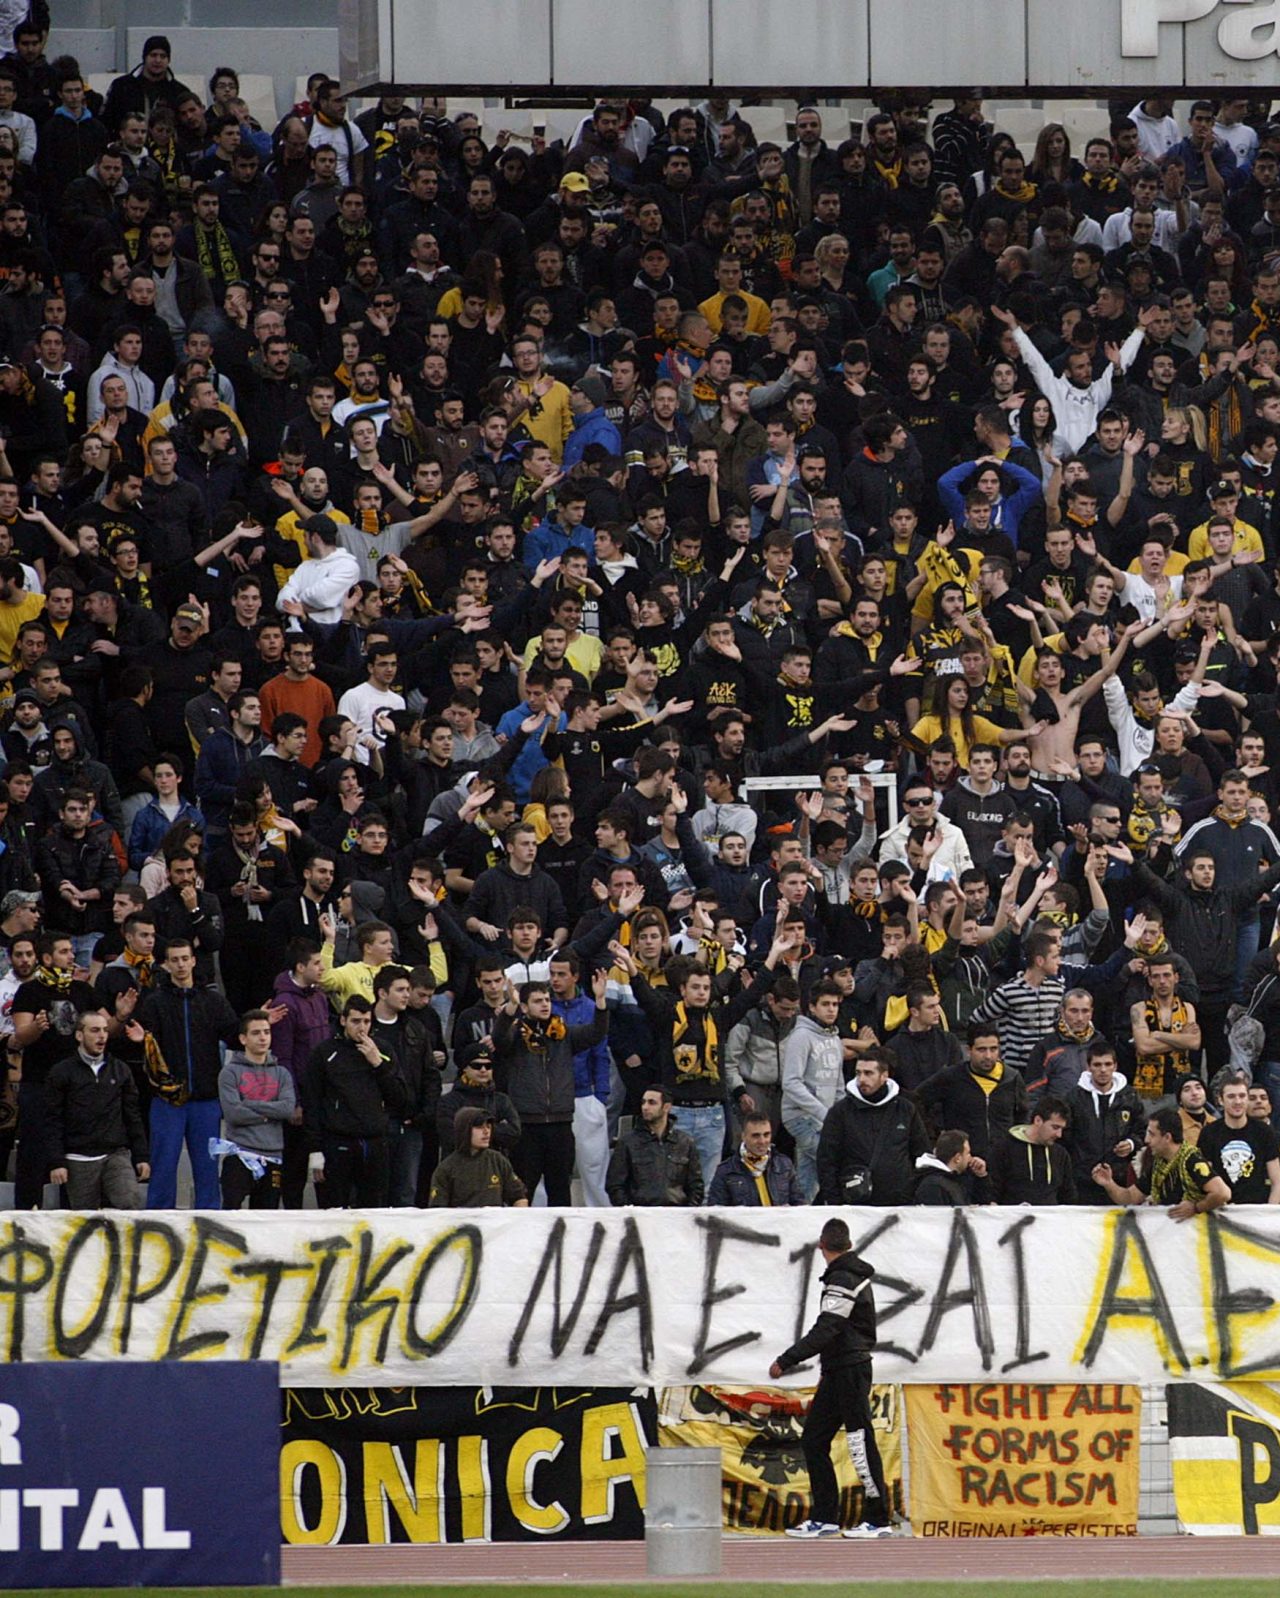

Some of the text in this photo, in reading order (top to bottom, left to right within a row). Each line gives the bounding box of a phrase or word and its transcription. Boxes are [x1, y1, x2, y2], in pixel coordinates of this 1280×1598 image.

[507, 1215, 656, 1374] ΝΑ
[934, 1383, 1134, 1421] FIGHT ALL
[943, 1424, 1134, 1465] FORMS OF
[280, 1402, 647, 1546] ONICA
[956, 1465, 1118, 1507] RACISM
